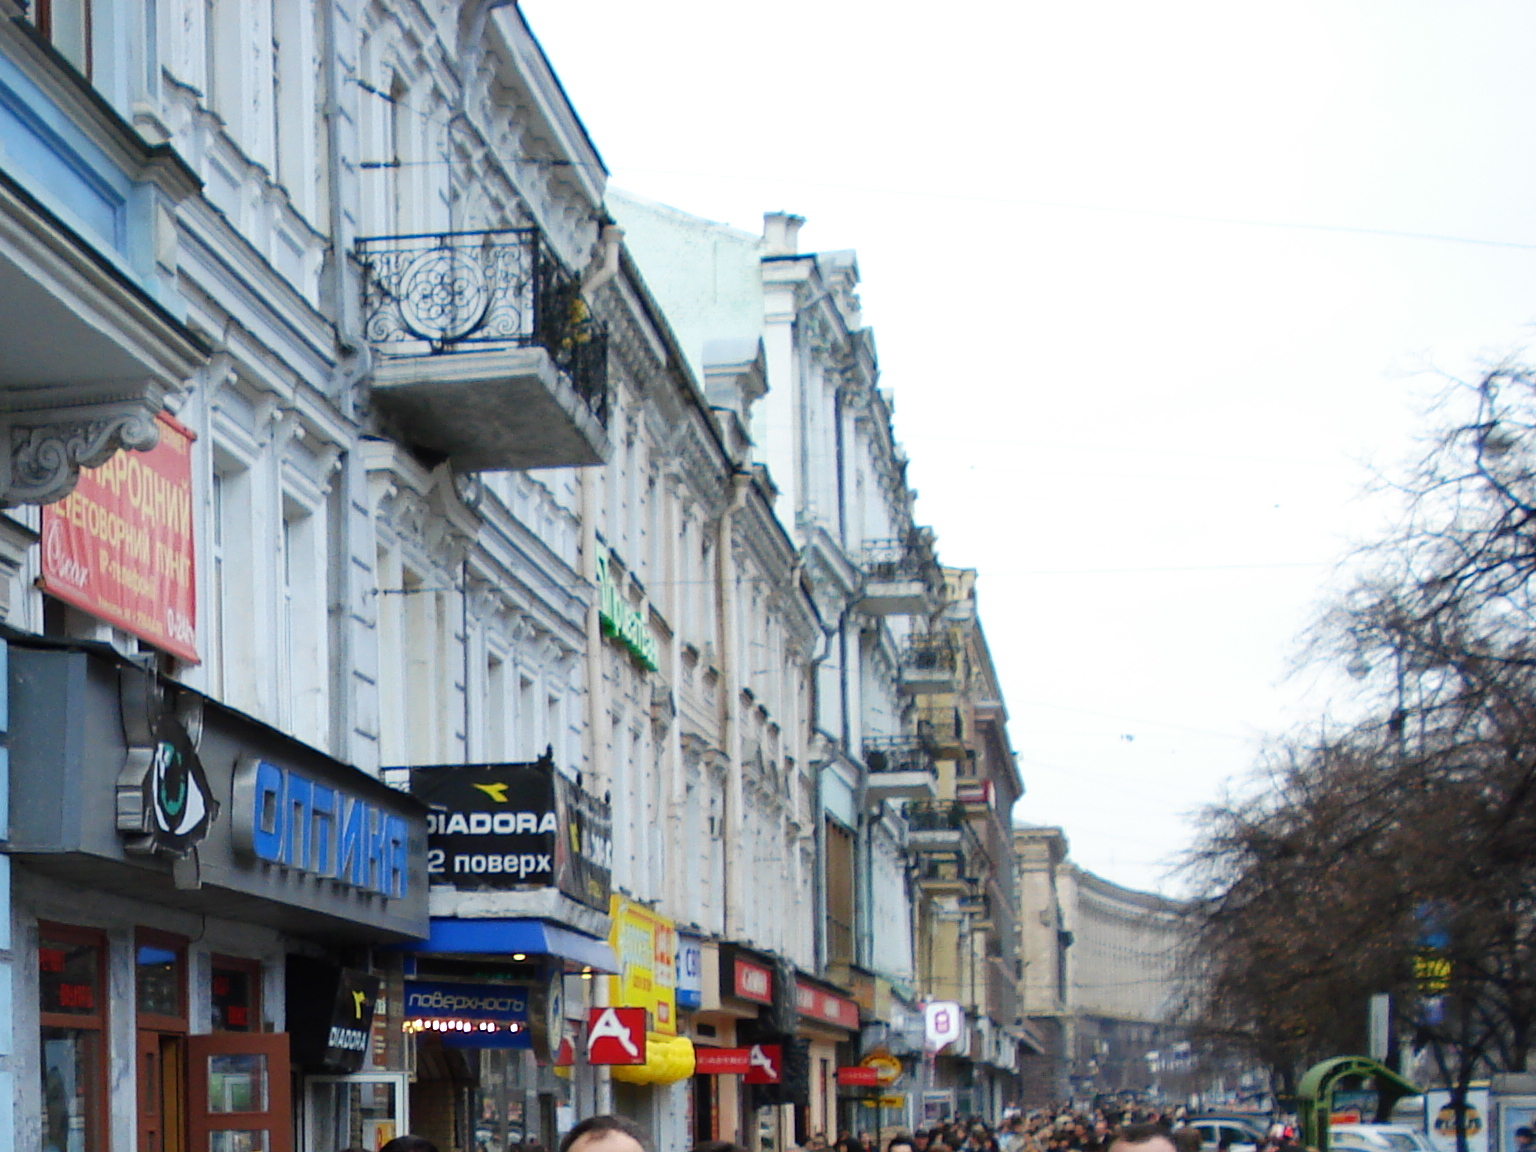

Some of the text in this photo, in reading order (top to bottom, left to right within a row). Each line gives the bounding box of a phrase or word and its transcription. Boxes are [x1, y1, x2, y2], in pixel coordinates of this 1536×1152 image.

[252, 759, 408, 899] ОПТИКА
[427, 848, 552, 879] 2 поверх
[408, 990, 525, 1013] поверхность
[328, 1026, 367, 1052] DIADORA
